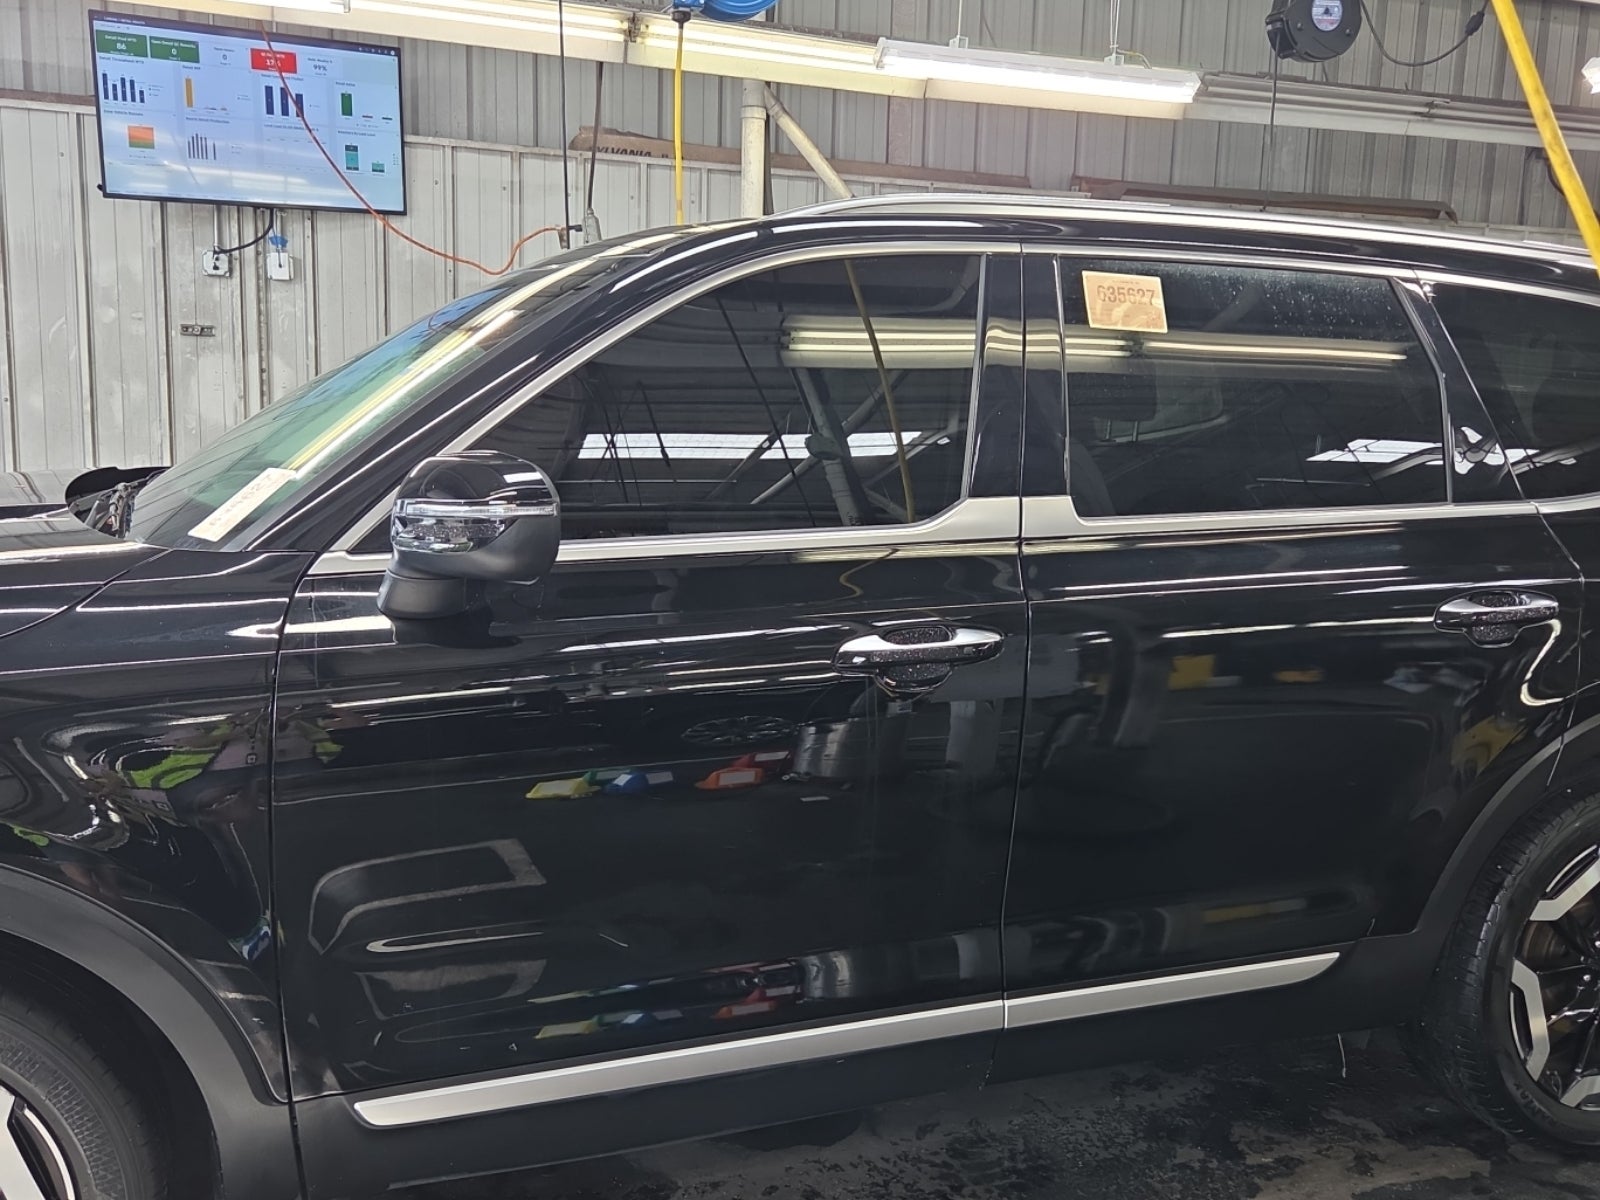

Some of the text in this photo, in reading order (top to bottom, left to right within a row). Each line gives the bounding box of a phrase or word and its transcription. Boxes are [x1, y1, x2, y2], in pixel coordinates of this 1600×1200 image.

[116, 42, 127, 50] 86
[589, 146, 652, 157] YLVANIA
[1096, 285, 1155, 306] 635627
